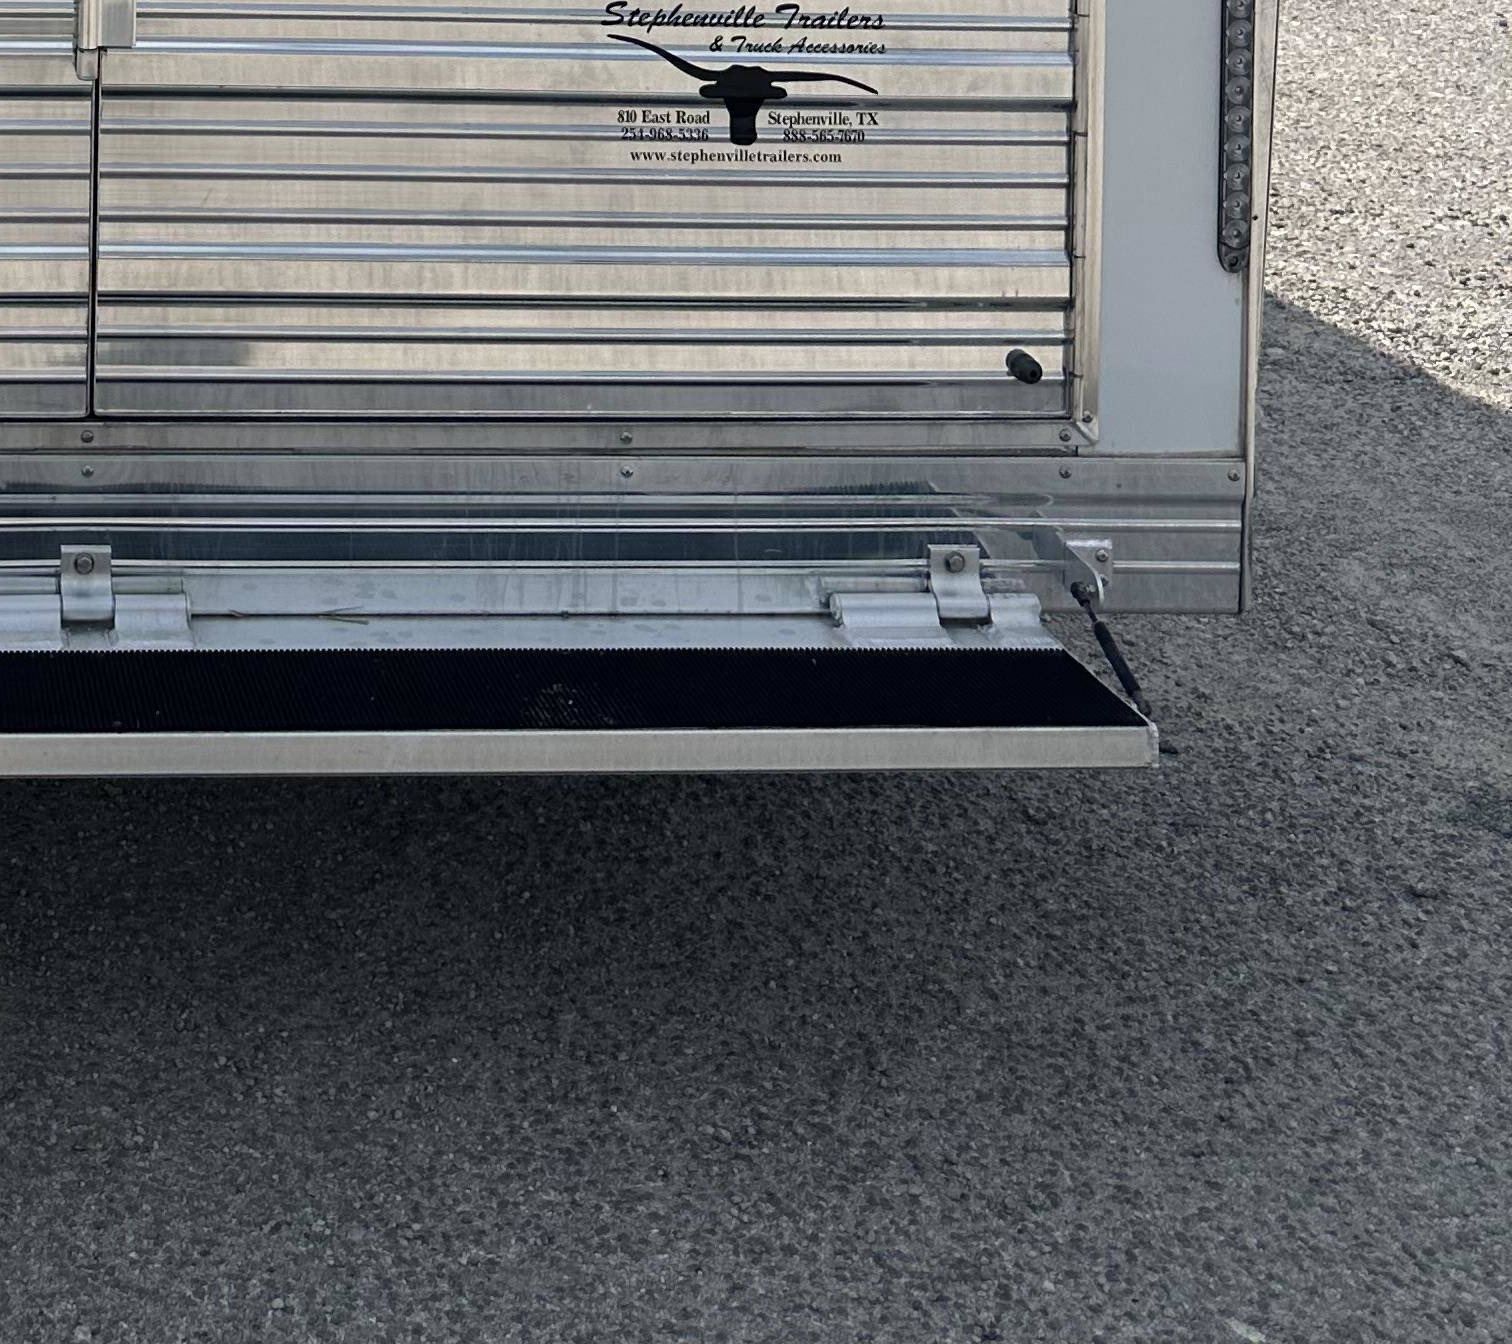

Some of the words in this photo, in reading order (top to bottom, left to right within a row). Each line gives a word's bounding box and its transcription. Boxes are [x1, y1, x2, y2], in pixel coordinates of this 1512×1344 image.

[601, 0, 766, 33] Stephenville
[775, 3, 886, 30] Trailers
[709, 35, 723, 52] &
[731, 35, 783, 54] Truck
[787, 36, 887, 54] Accessories
[616, 110, 637, 123] 810
[641, 110, 671, 124] East
[676, 111, 710, 125] Road
[768, 111, 853, 129] Stephenville,
[857, 112, 879, 126] TX
[630, 149, 842, 165] www.stephenvilletrailers.com
